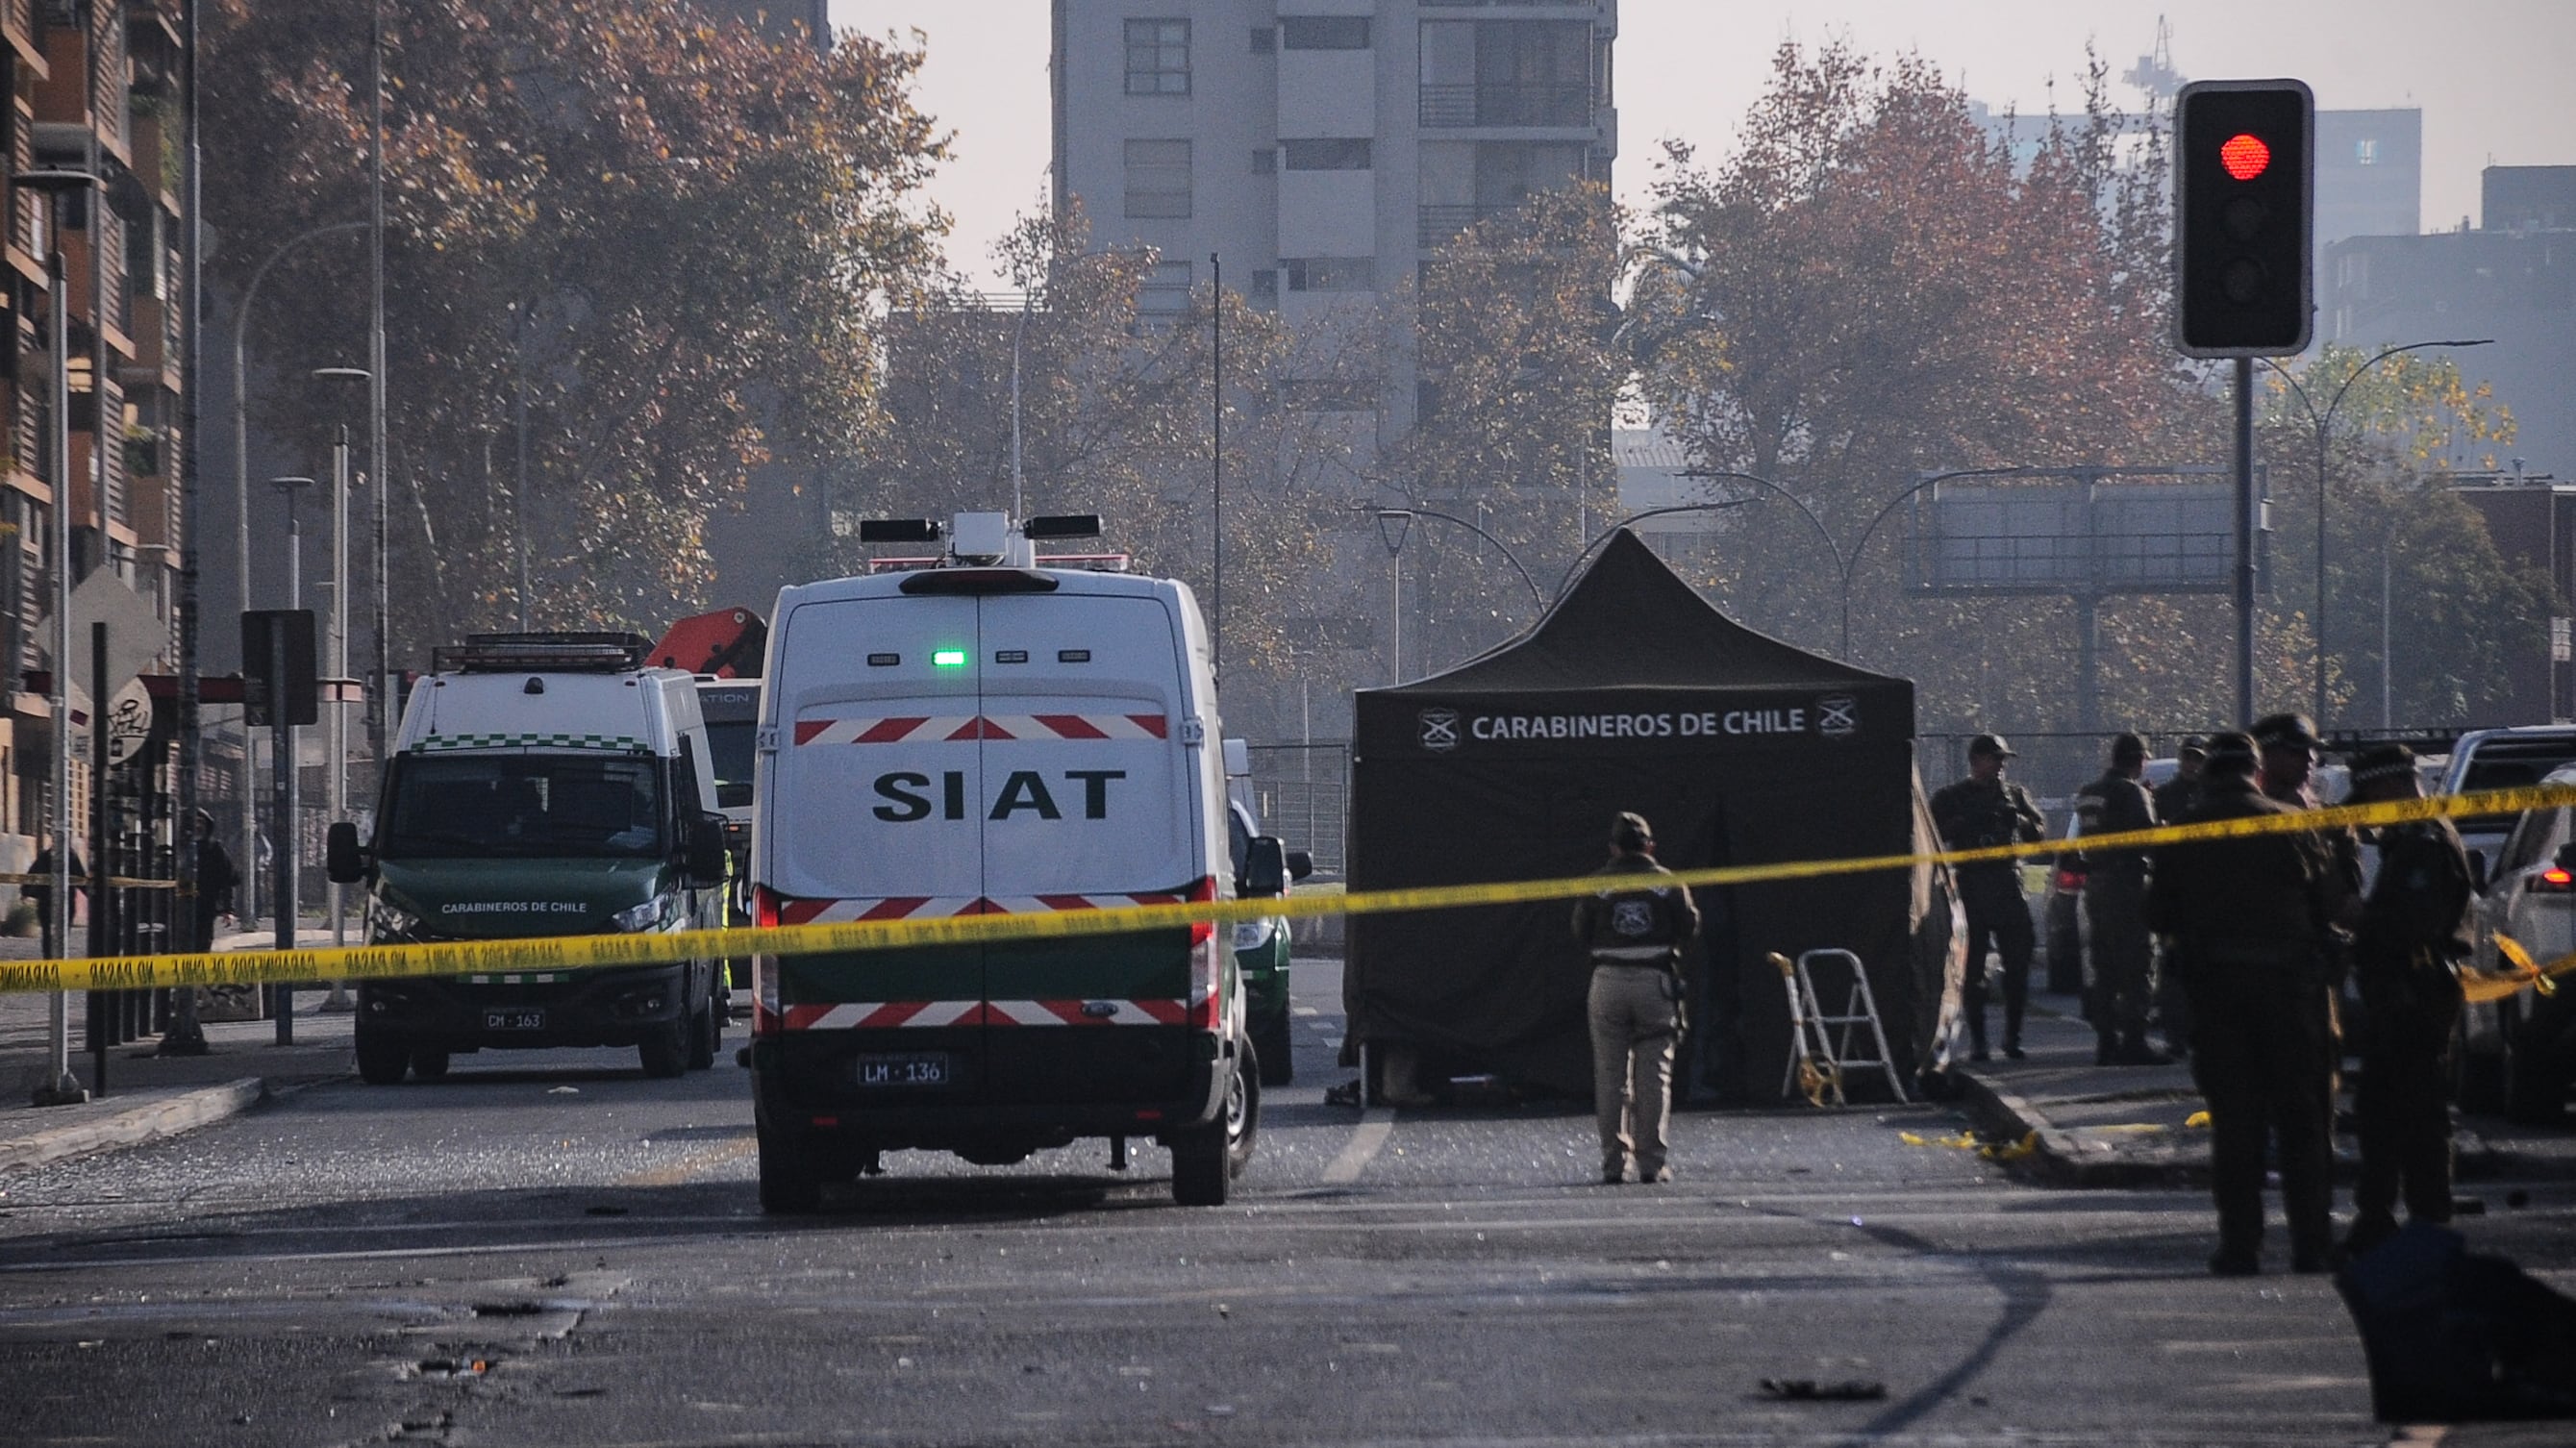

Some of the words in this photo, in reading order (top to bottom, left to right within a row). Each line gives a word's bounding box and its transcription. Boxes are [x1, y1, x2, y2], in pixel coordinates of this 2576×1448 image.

[1471, 713, 1671, 739] CARABINEROS
[1680, 712, 1717, 736] DE
[1723, 709, 1805, 735] CHILE
[872, 770, 1127, 822] SIAT
[441, 902, 528, 913] CARABINEROS
[531, 902, 547, 912] DE
[550, 902, 588, 912] CHILE
